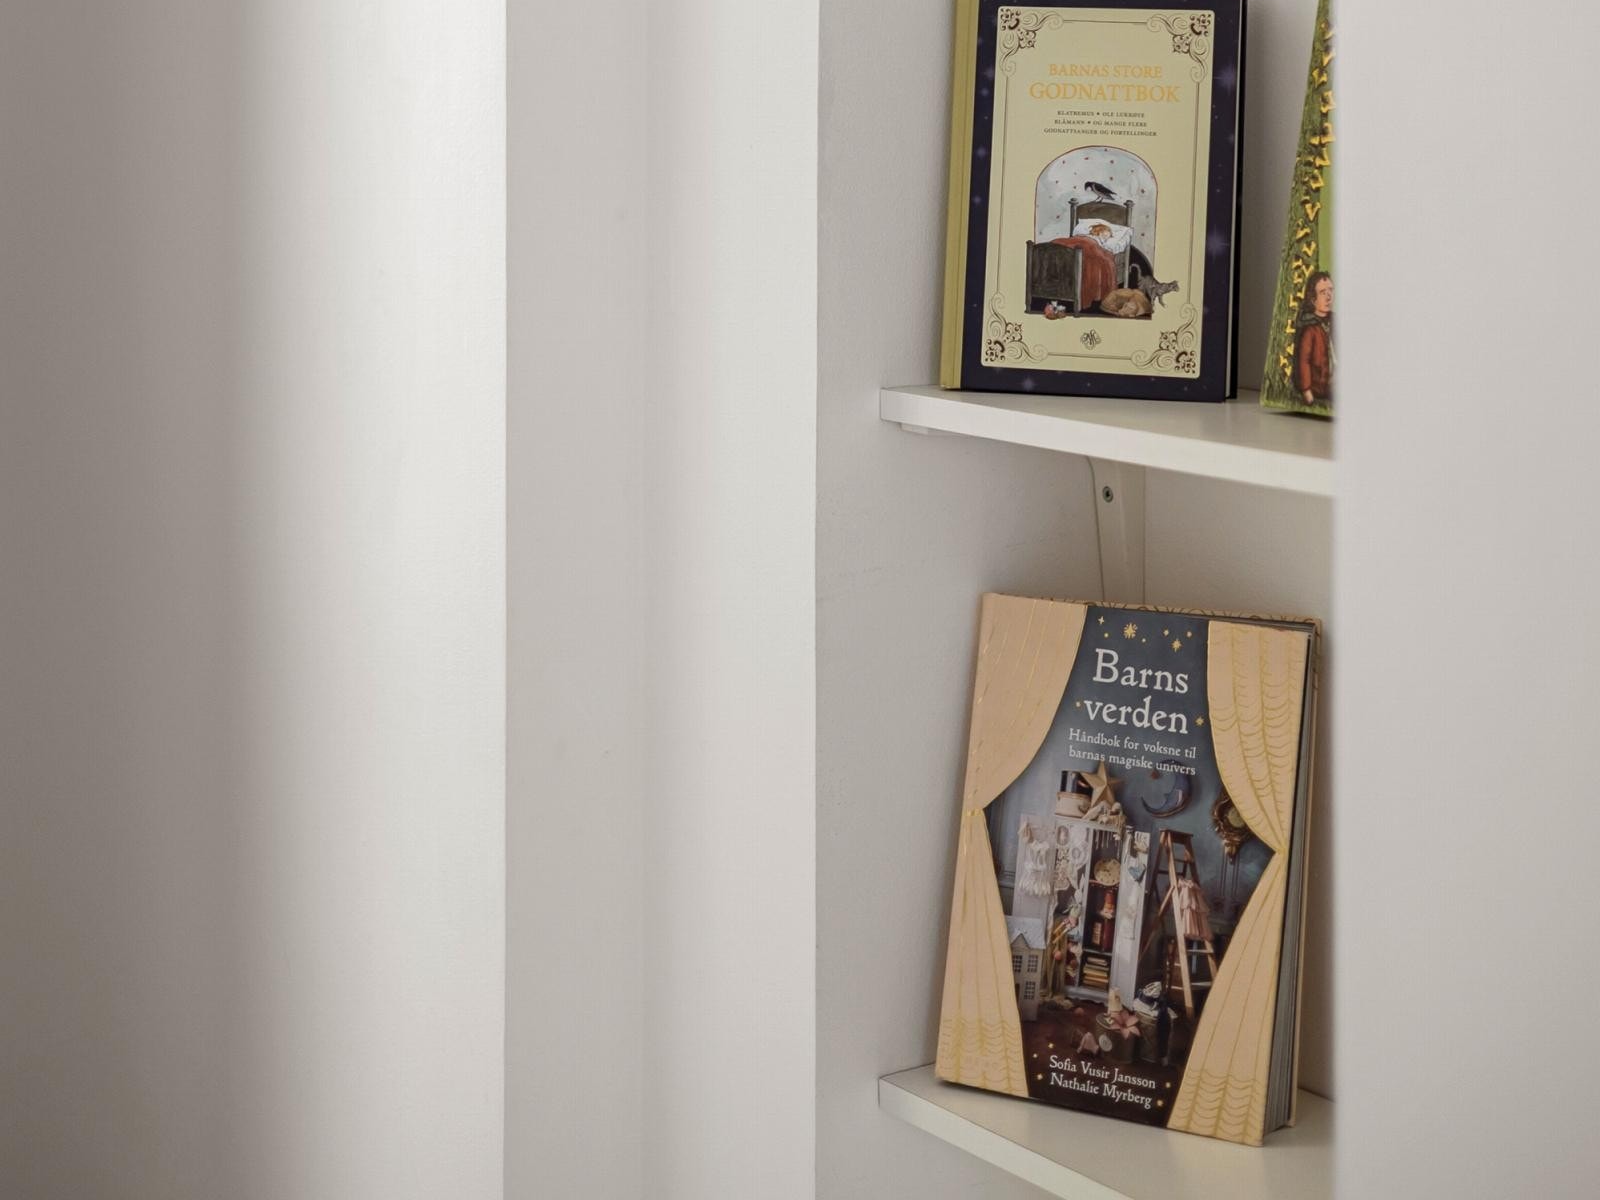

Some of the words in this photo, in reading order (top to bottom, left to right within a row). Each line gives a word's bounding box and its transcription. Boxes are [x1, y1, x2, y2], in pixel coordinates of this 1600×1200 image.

[1049, 63, 1110, 77] BARNAS
[1113, 65, 1163, 79] STORE
[1029, 82, 1181, 103] GODNATTBOK
[1110, 129, 1157, 137] FORTELLINGER
[1092, 648, 1189, 694] Barns
[1083, 695, 1188, 735] verden
[1069, 727, 1120, 748] Håndbok
[1123, 736, 1139, 750] for
[1143, 741, 1181, 757] voksne
[1184, 746, 1197, 759] til
[1069, 745, 1105, 762] barnas
[1109, 755, 1153, 770] magiske
[1156, 760, 1196, 776] univers
[1049, 1054, 1077, 1072] Sofia
[1081, 1060, 1110, 1079] Vusir
[1111, 1067, 1156, 1089] Jansson
[1050, 1072, 1099, 1095] Nathalie
[1102, 1083, 1152, 1110] Myrberg
